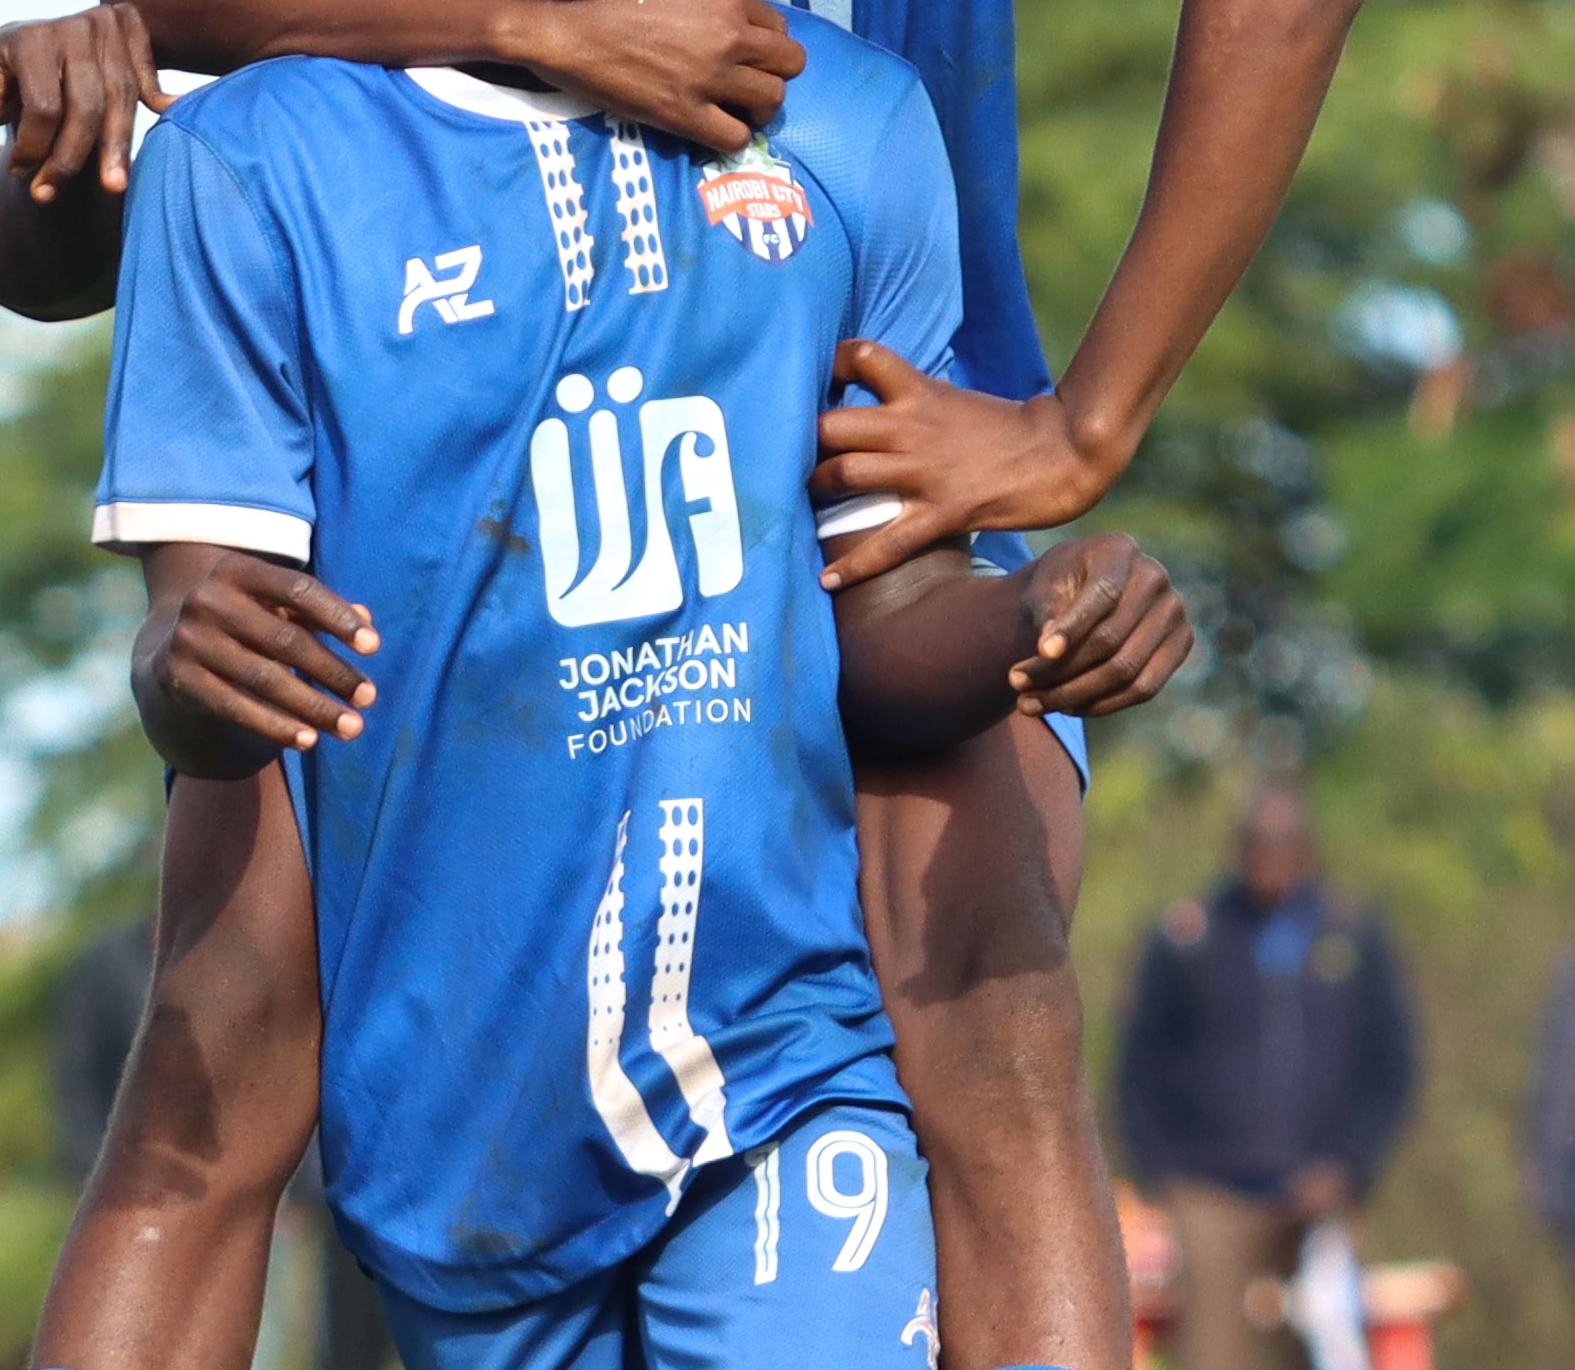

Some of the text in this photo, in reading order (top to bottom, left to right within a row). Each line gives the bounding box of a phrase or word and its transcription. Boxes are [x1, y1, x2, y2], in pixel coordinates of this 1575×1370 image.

[706, 179, 770, 211] NAIROBI
[559, 622, 749, 690] JONATHAN
[577, 657, 736, 722] JACKSON
[567, 698, 751, 759] FOUNDATION
[745, 1130, 888, 1285] 19
